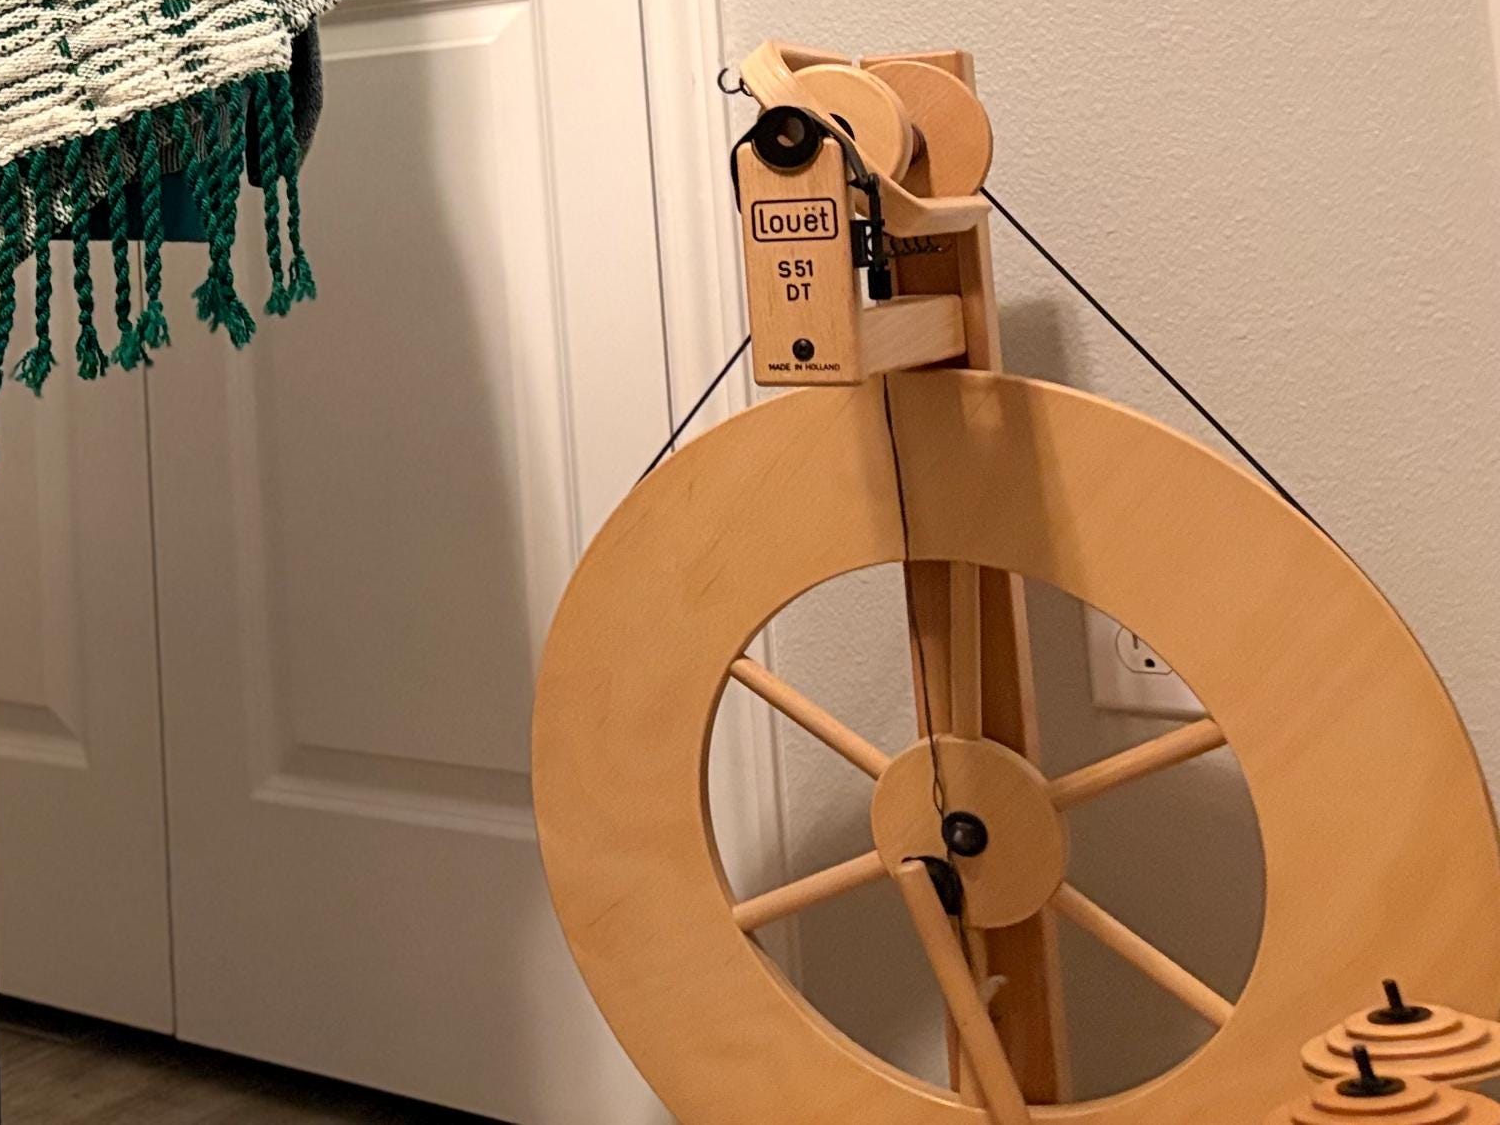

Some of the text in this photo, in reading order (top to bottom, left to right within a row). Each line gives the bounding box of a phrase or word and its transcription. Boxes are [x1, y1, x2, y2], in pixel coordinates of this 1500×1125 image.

[759, 206, 829, 234] louët
[787, 283, 811, 301] DT
[768, 363, 841, 371] MADE IN HOLLAND
